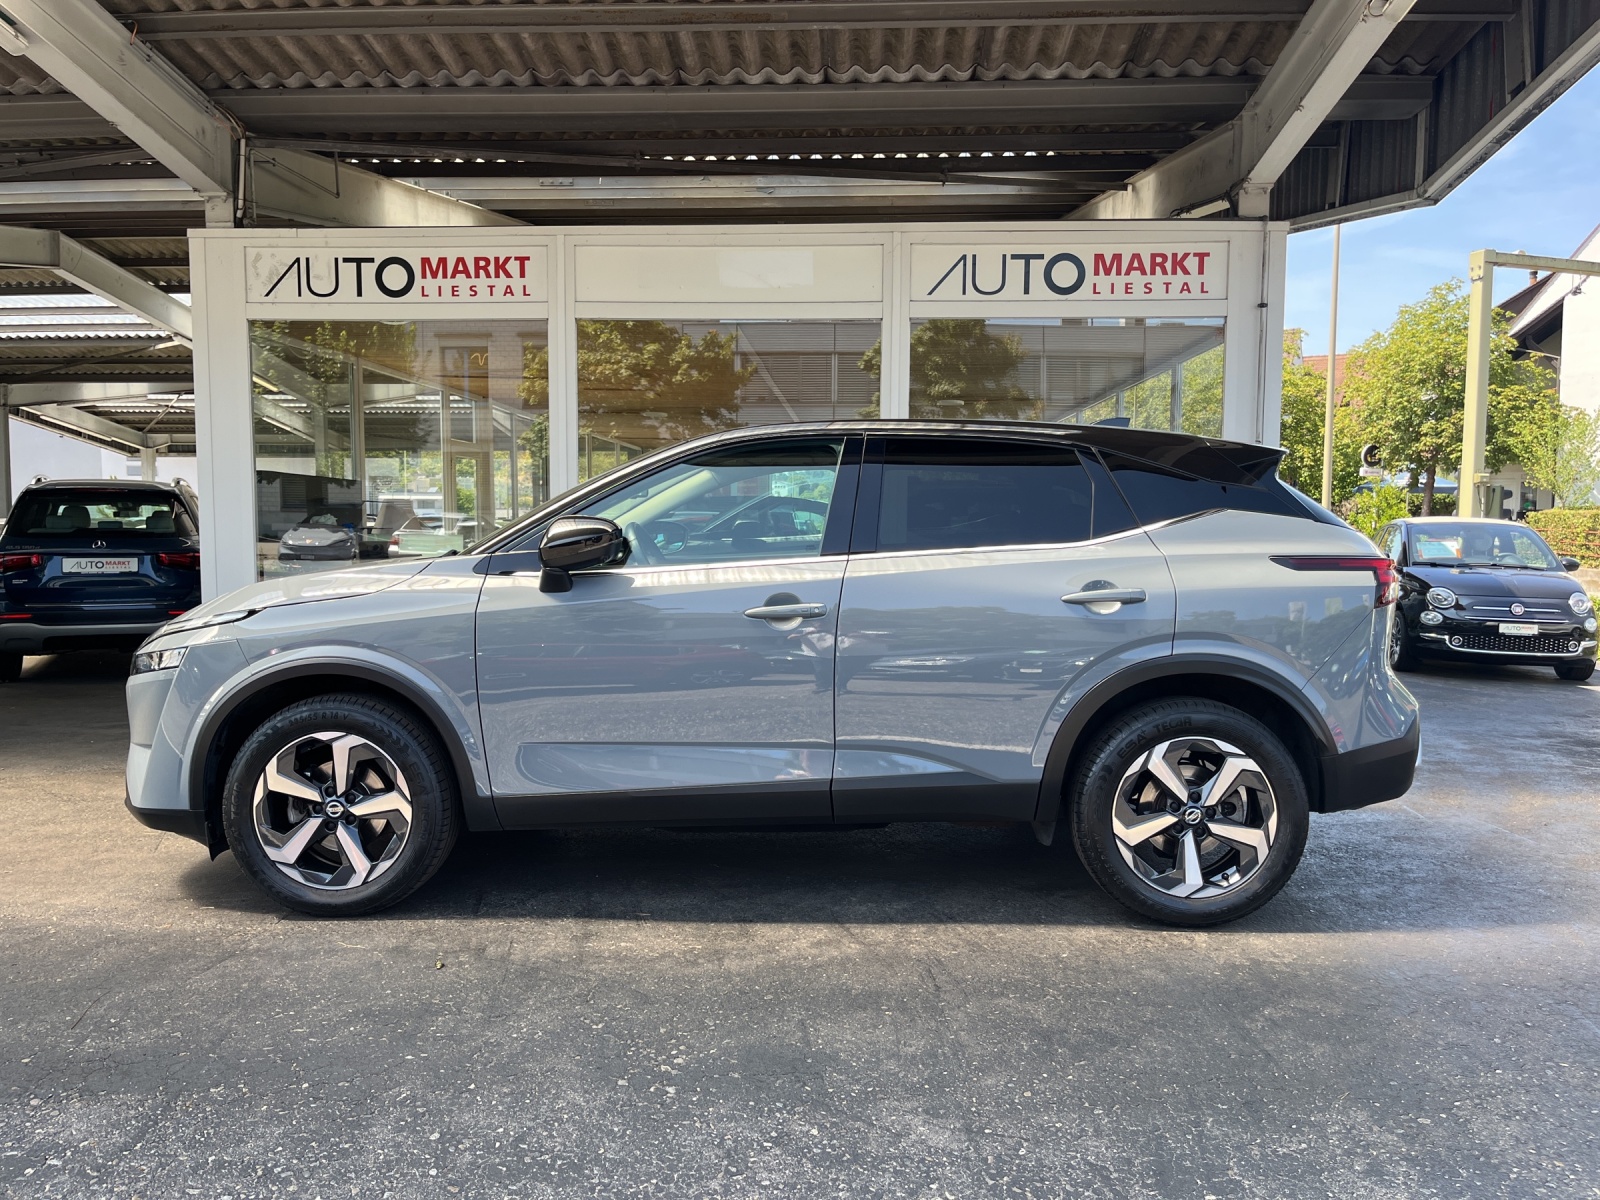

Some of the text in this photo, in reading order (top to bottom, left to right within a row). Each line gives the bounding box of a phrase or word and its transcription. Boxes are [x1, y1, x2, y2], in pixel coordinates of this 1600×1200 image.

[263, 256, 531, 298] AUTO MARKT
[926, 252, 1210, 296] AUTO MARKT
[420, 285, 531, 297] LIESTAL
[1092, 281, 1209, 295] LIESTAL
[70, 560, 105, 570] AUTO
